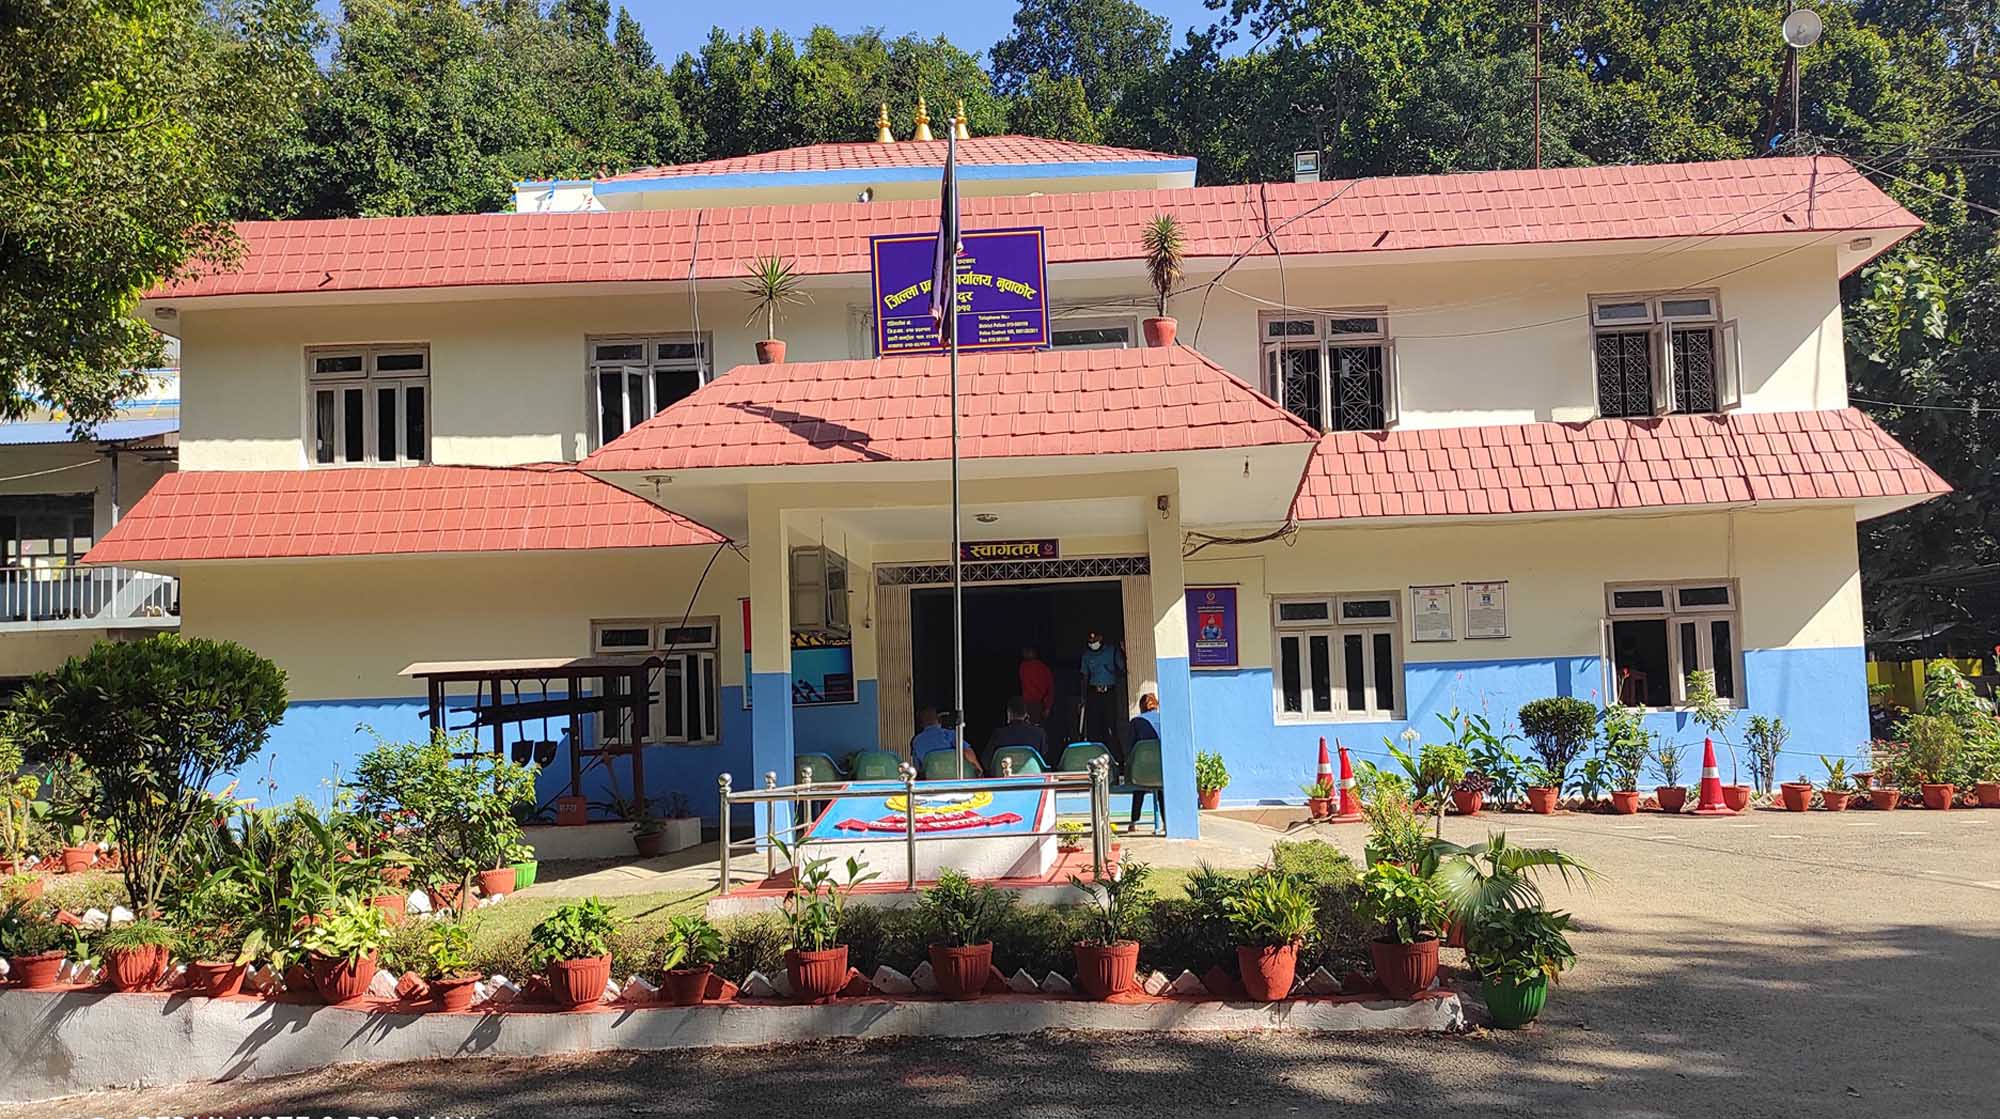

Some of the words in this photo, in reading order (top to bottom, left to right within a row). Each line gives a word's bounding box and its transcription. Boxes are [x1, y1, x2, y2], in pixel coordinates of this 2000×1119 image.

[884, 284, 919, 310] जिल्ला
[996, 277, 1037, 300] नुवाकोट
[969, 543, 1041, 558] स्वागतम्
